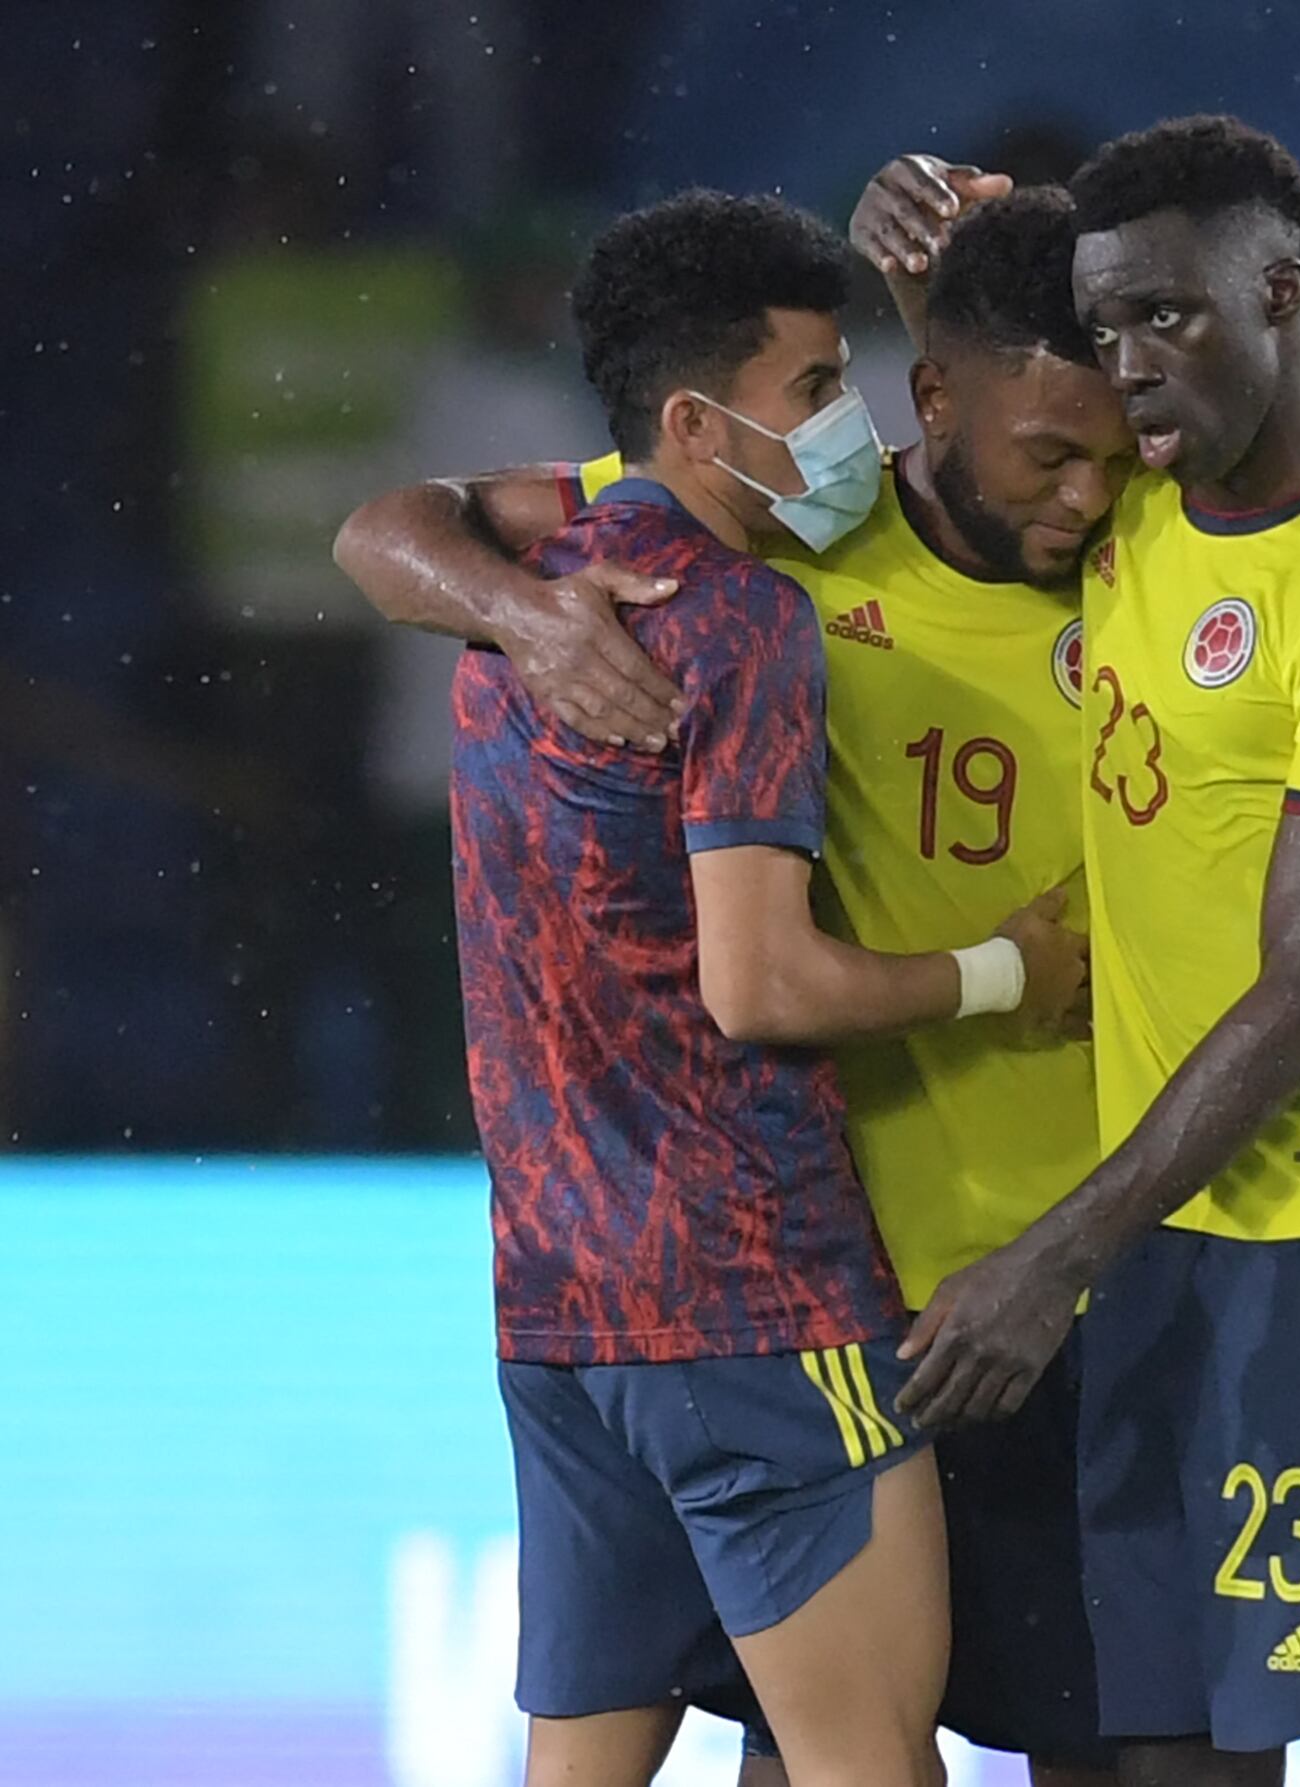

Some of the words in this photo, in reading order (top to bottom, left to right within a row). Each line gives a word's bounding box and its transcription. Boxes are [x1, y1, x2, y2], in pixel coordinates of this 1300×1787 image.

[825, 622, 894, 650] adidas
[905, 727, 1017, 866] 19
[1090, 665, 1169, 827] 23
